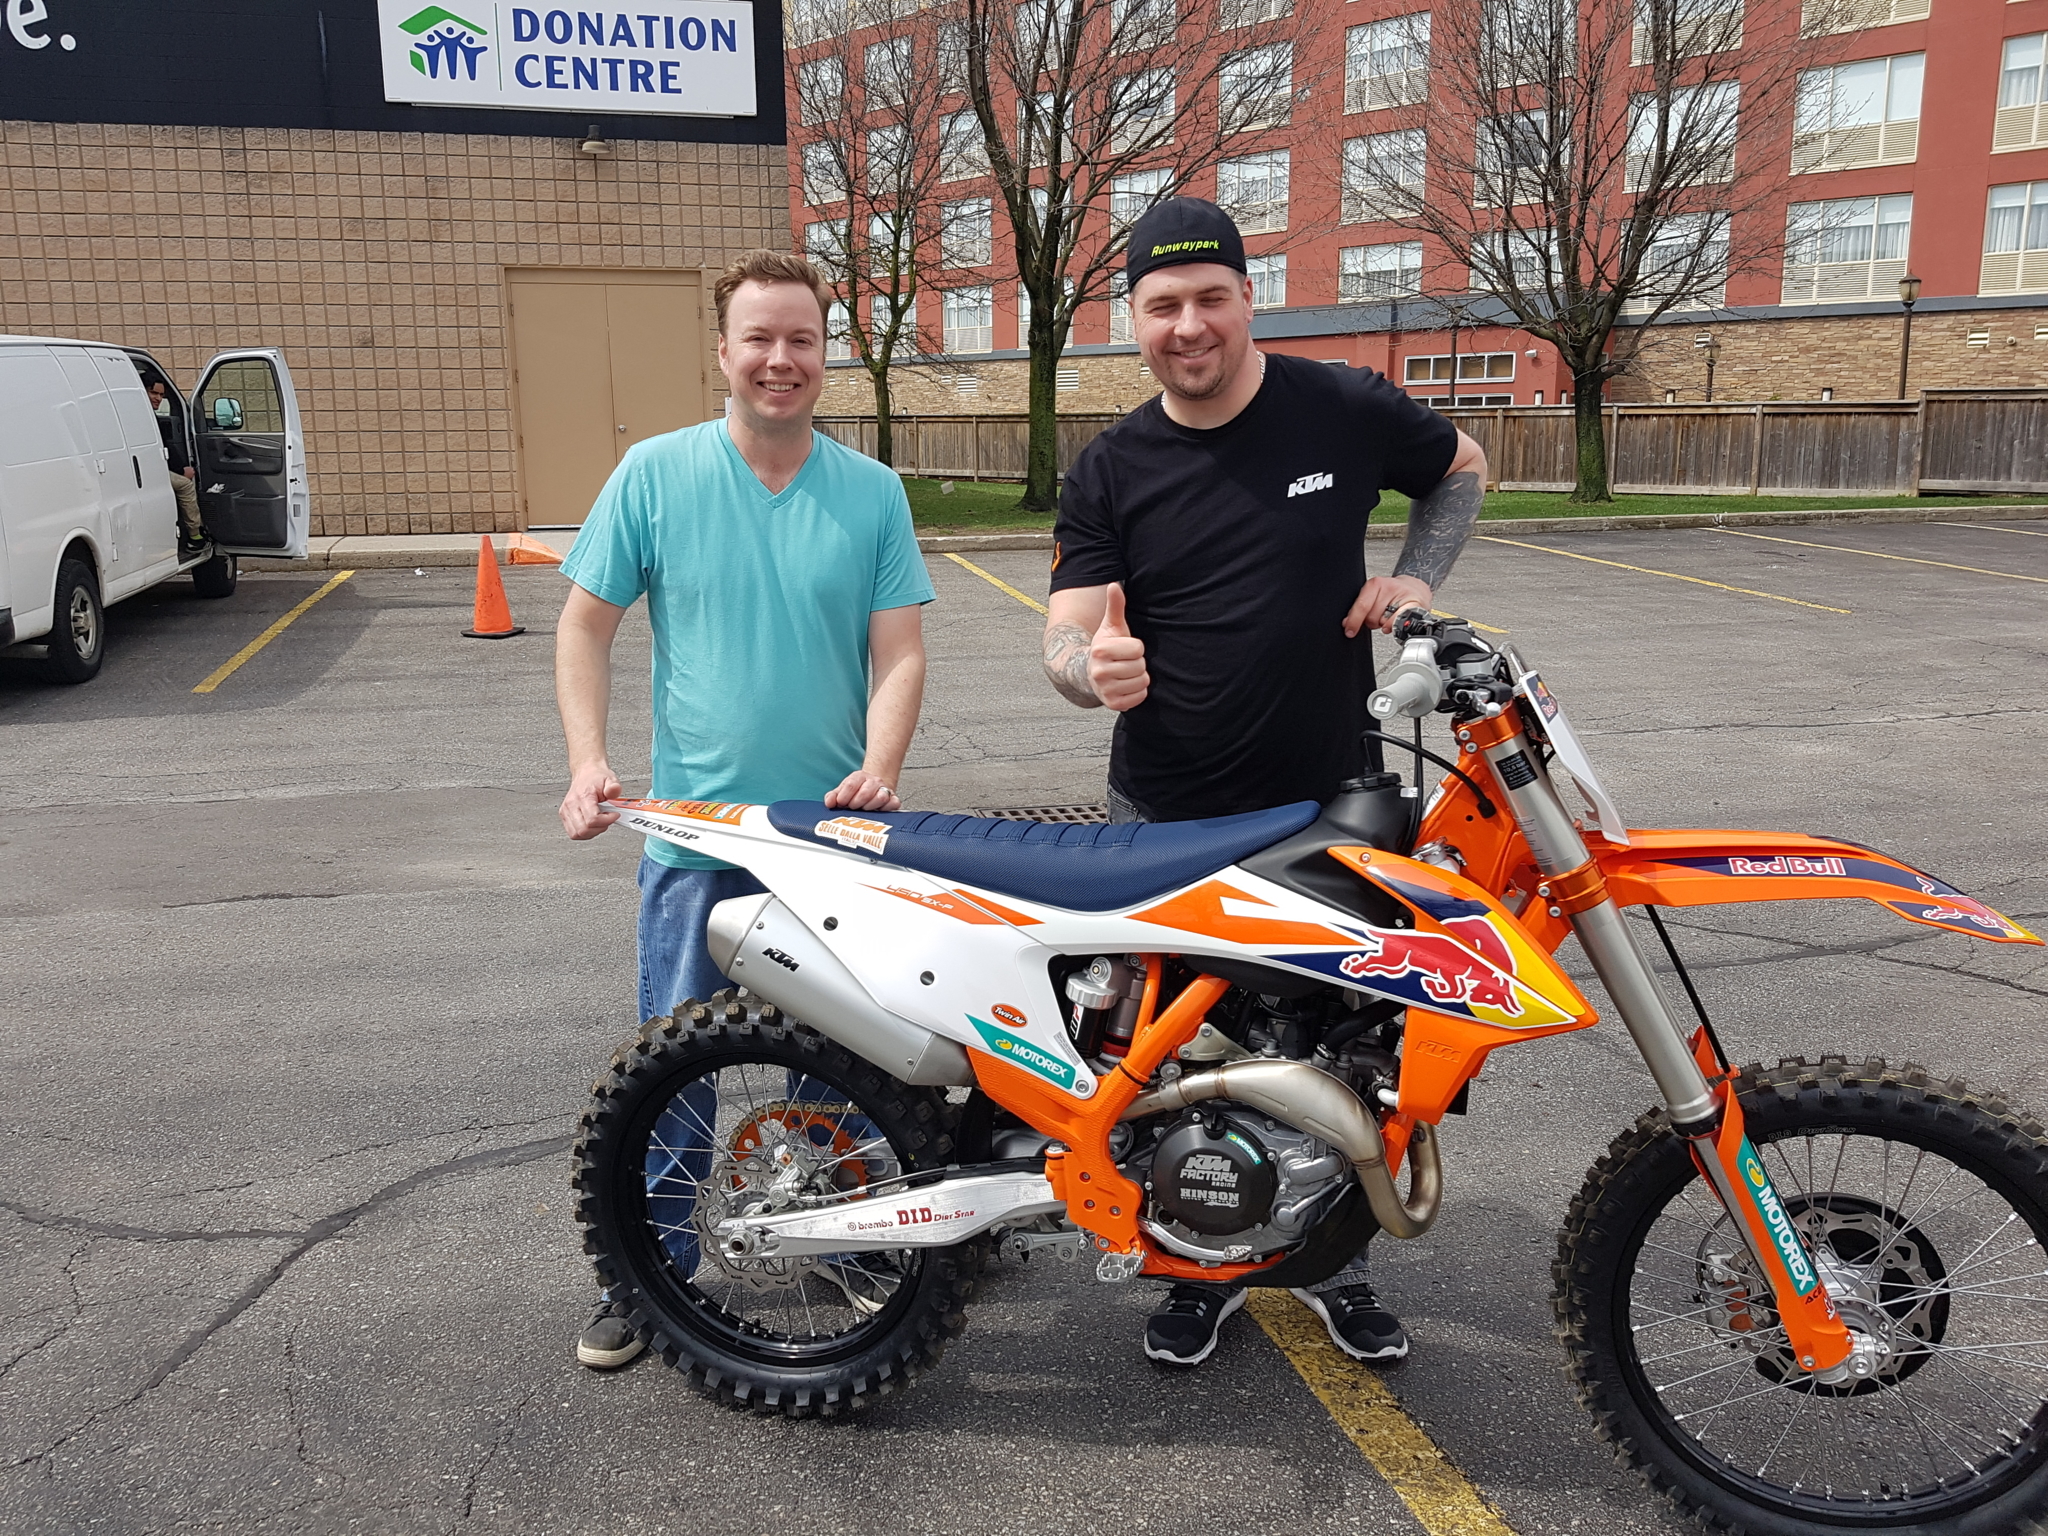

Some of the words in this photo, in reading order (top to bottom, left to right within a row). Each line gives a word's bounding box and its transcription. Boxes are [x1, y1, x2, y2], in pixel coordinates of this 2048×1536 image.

[0, 0, 76, 51] e.
[512, 8, 737, 52] DONATION
[515, 54, 682, 94] CENTRE
[1151, 240, 1219, 257] Runwaypark
[1287, 472, 1333, 498] KTM
[629, 817, 700, 840] DUNLOP
[819, 822, 839, 835] SELLE
[840, 829, 861, 841] DALLA
[863, 834, 884, 849] VALLE
[832, 818, 886, 833] KTM
[1728, 857, 1788, 874] Red
[1787, 857, 1846, 875] Bull
[886, 884, 923, 899] 450
[762, 947, 800, 972] KTM
[994, 1006, 1013, 1020] Twin
[1012, 1016, 1026, 1025] Air
[1012, 1044, 1069, 1079] MOTOREX
[1185, 1154, 1232, 1172] KTM
[1180, 1168, 1238, 1182] FACTORY
[1180, 1187, 1239, 1202] HINSON
[858, 1219, 893, 1230] brembo
[1758, 1186, 1814, 1291] MOTOREX
